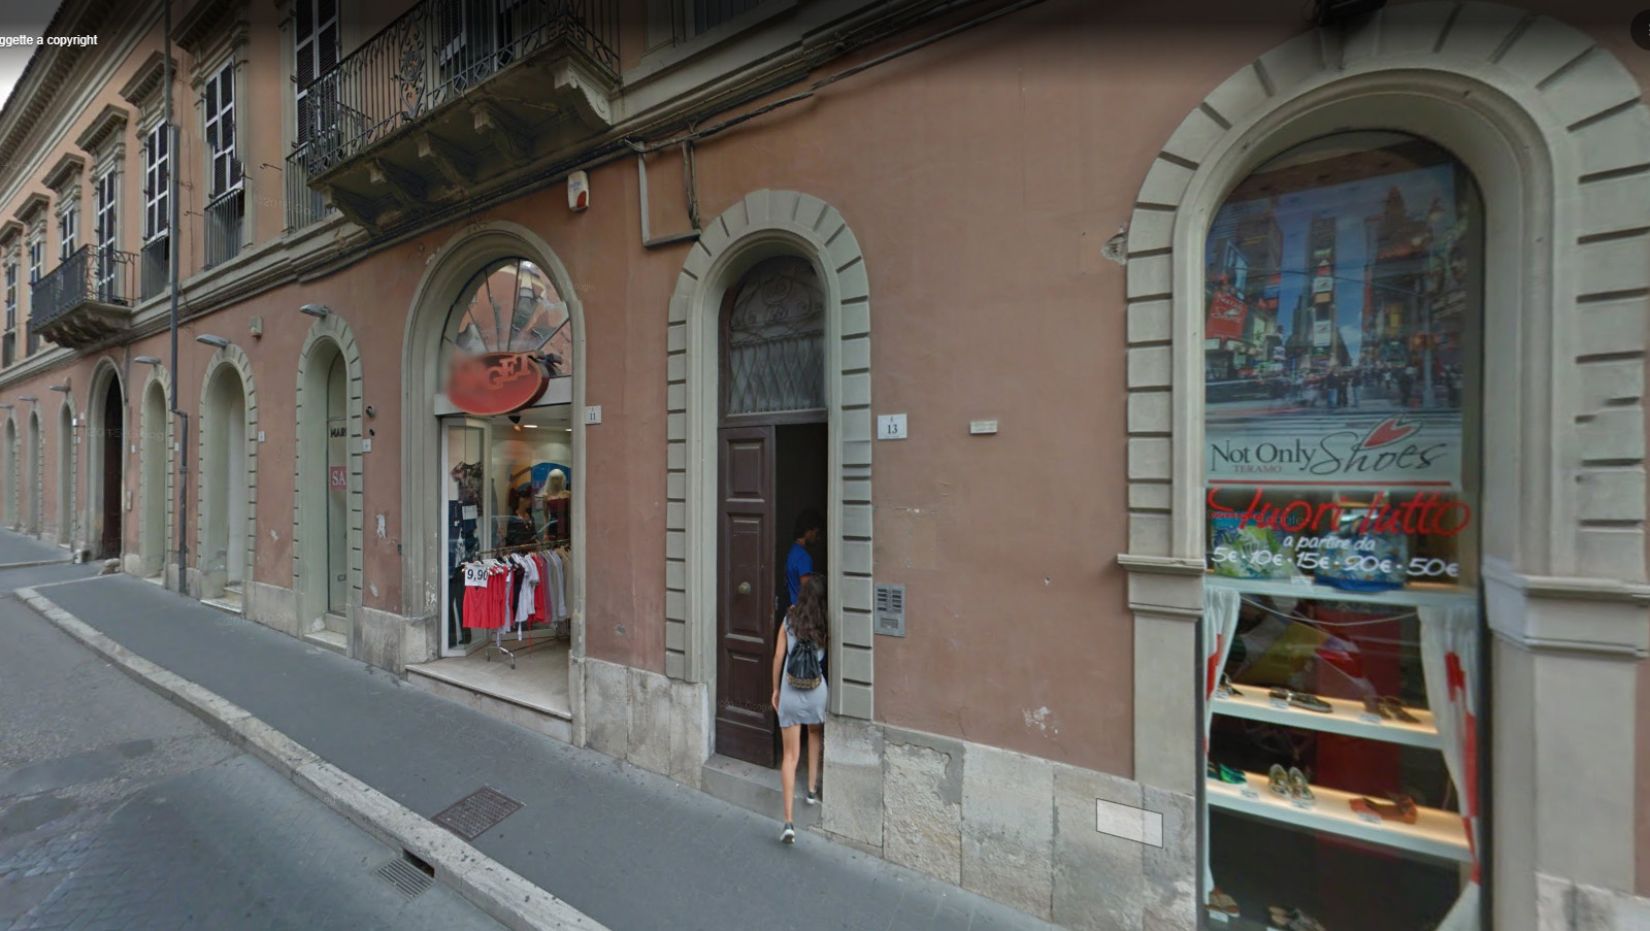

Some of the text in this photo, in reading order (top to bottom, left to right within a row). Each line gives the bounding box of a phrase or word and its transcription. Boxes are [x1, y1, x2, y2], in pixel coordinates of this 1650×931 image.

[887, 424, 898, 435] 13
[1211, 431, 1447, 475] Not Only Shoes
[1233, 464, 1282, 473] TERAMO
[1282, 535, 1294, 547] a
[1353, 536, 1377, 551] da
[1406, 557, 1459, 577] 50€
